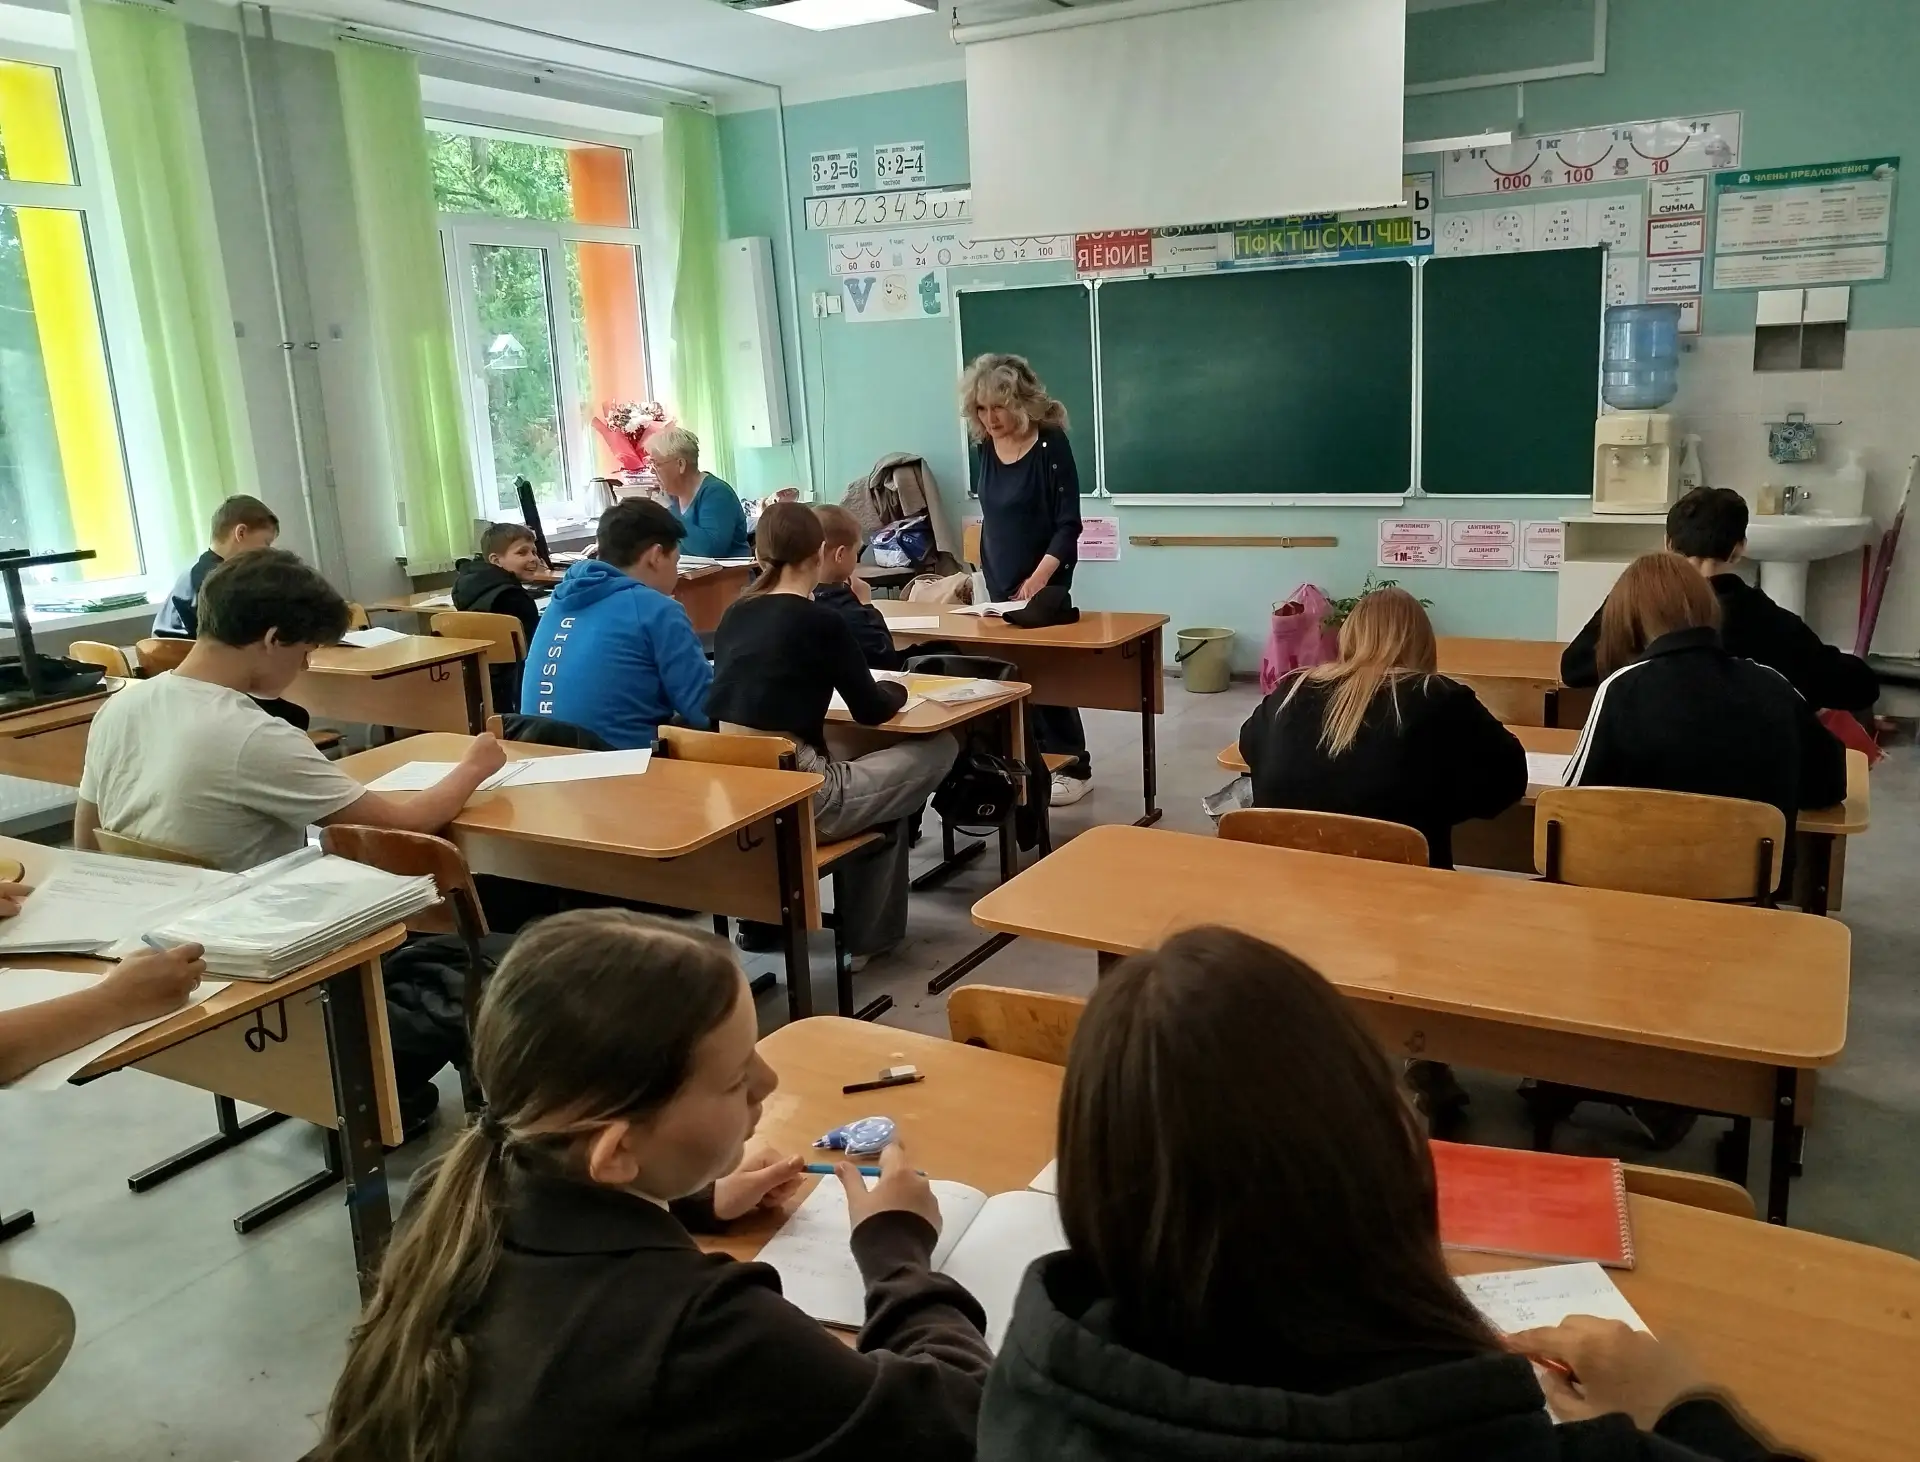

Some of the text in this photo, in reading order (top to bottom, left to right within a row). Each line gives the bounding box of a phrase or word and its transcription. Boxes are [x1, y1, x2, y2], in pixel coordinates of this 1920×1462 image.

[1652, 160, 1669, 174] 10
[1754, 164, 1869, 182] ЧЛЕНЫ ПРЕДЛОЖЕНИЯ
[1564, 167, 1594, 183] 100
[1493, 174, 1532, 190] 1000
[854, 197, 867, 224] 2
[873, 195, 887, 223] 3
[894, 194, 906, 221] 4
[913, 191, 927, 220] 5
[1659, 203, 1695, 213] СУММА
[1652, 221, 1700, 229] УМЕНЬШАЕМОЕ
[1037, 247, 1053, 256] 100
[848, 262, 858, 270] 60
[870, 260, 881, 269] 60
[916, 257, 926, 266] 24
[539, 616, 576, 714] RUSSIA
